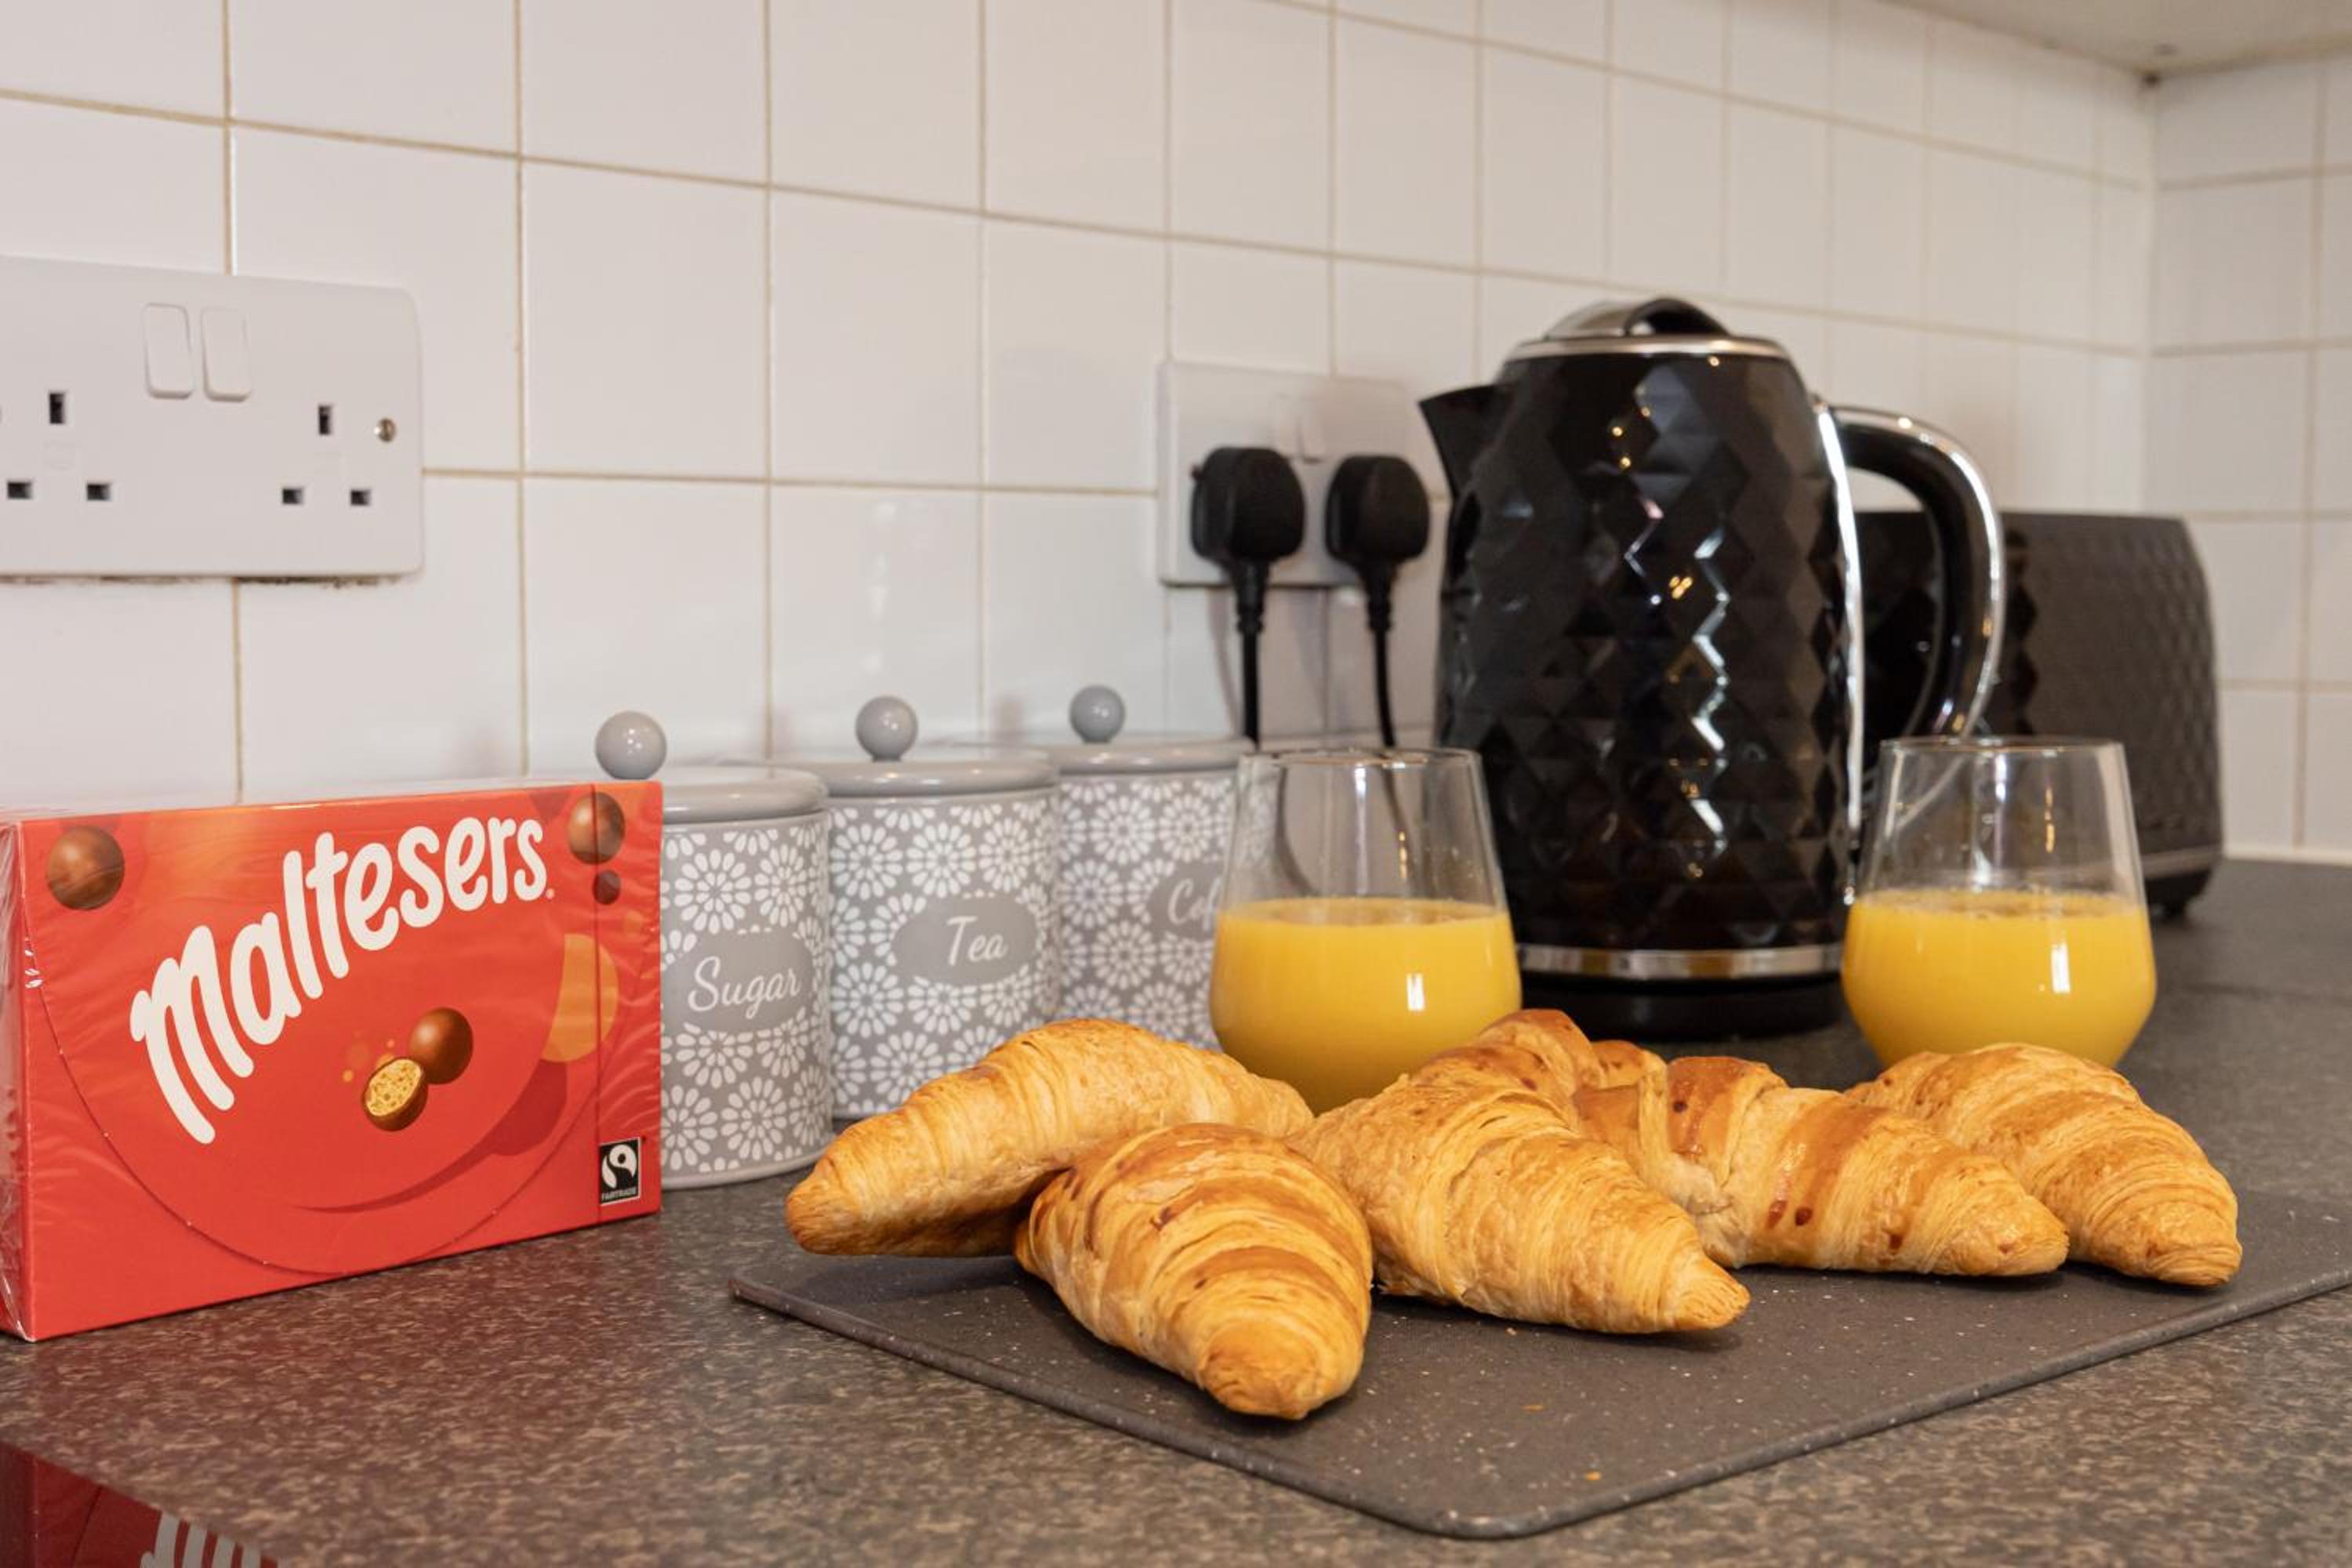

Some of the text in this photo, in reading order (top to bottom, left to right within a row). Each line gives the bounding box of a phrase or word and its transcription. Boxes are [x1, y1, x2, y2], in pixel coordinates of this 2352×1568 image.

[1167, 877, 1221, 932] Cof
[946, 916, 1008, 966] Tea
[688, 956, 801, 1019] Sugar
